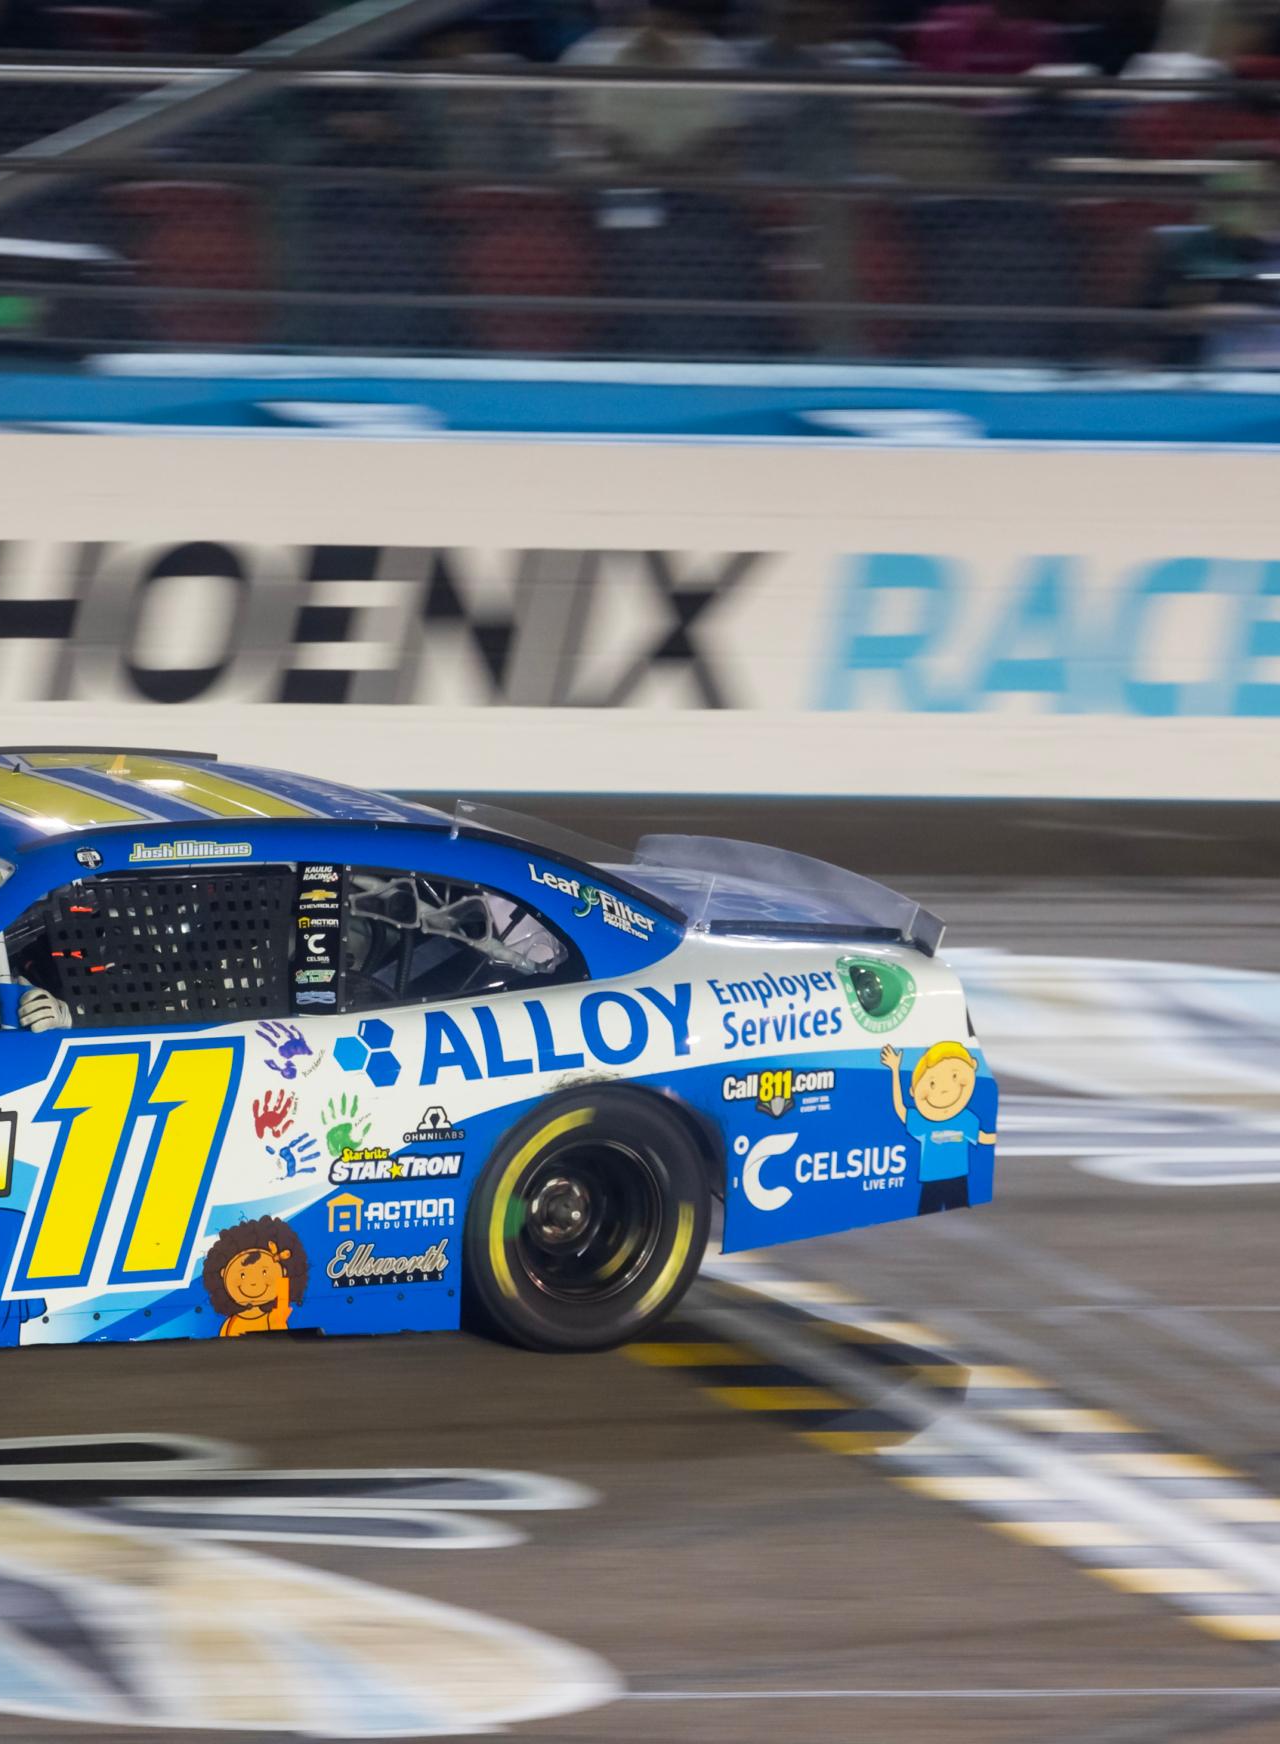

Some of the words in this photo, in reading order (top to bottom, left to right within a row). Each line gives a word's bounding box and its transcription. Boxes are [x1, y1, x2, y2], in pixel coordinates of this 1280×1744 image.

[132, 844, 174, 860] Josh
[177, 842, 250, 857] Williams
[303, 873, 333, 881] RACING
[707, 969, 838, 1008] Employer
[419, 983, 692, 1086] ALLOY
[722, 1003, 842, 1049] Services
[12, 1037, 245, 1291] 11
[795, 1145, 907, 1183] CELSIUS
[863, 1179, 885, 1191] LIVE
[888, 1177, 905, 1189] FIT
[364, 1197, 455, 1221] ACTION
[367, 1217, 455, 1230] INDUSTRIES
[327, 1238, 449, 1279] Ellsworth
[333, 1273, 443, 1287] ADVISORS
